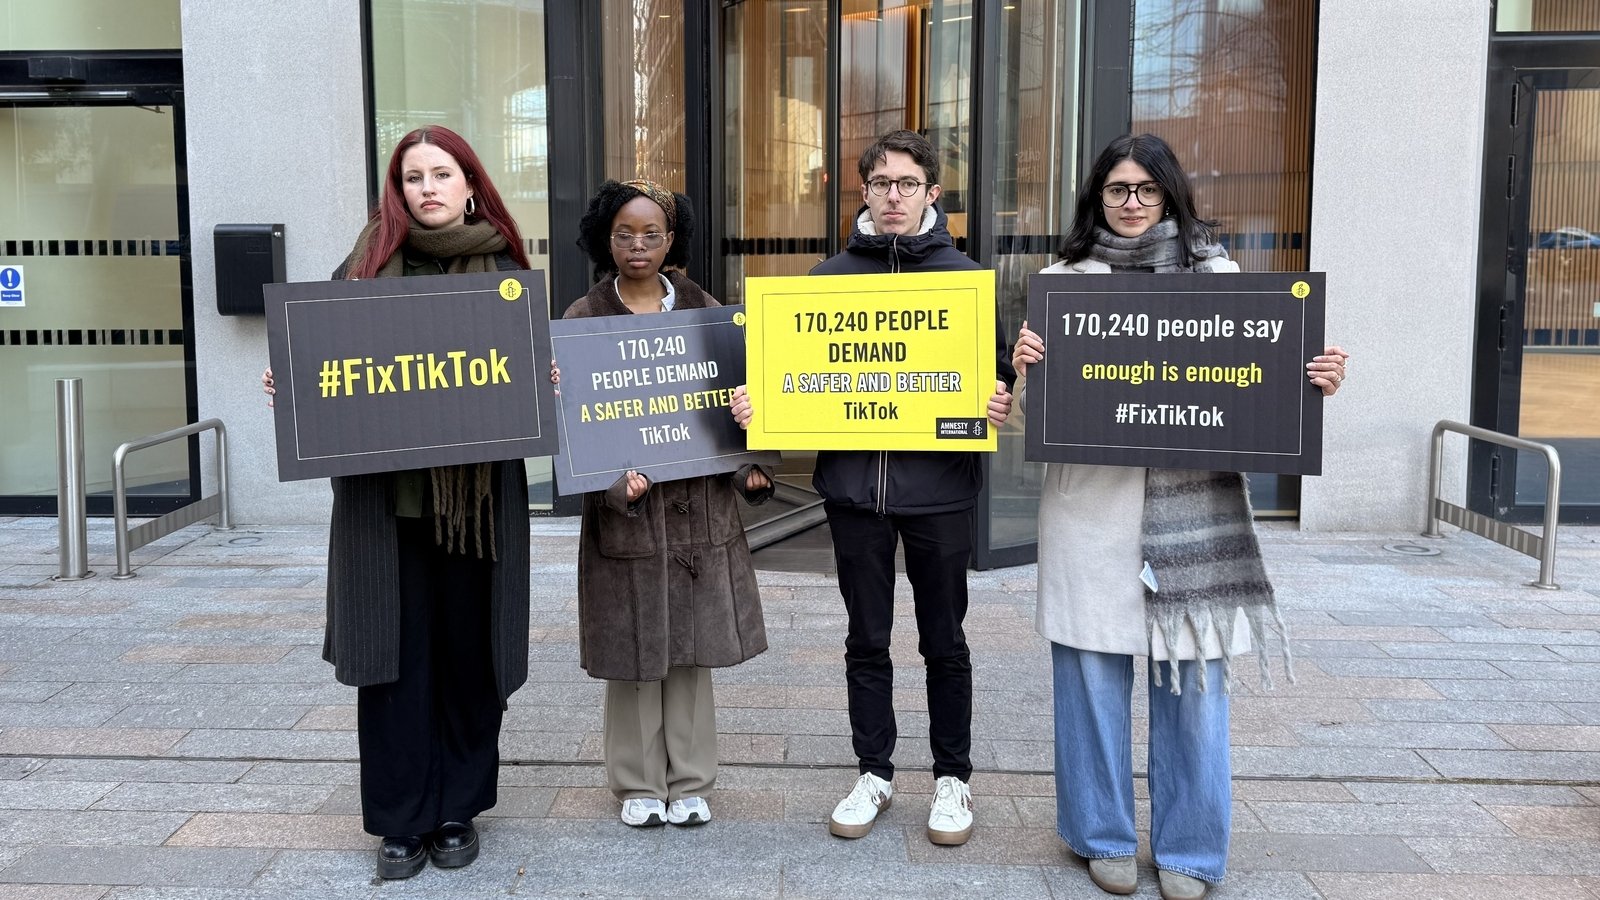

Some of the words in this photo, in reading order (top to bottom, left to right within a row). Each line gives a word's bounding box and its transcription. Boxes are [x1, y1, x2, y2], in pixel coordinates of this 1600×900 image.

[795, 312, 868, 335] 170,240
[875, 309, 949, 331] PEOPLE
[1062, 312, 1149, 339] 170,240
[1156, 314, 1235, 342] people
[1242, 319, 1284, 342] say
[617, 335, 686, 361] 170,240
[828, 341, 907, 363] DEMAND
[318, 348, 511, 398] #FixTikTok
[591, 367, 652, 391] PEOPLE
[656, 360, 719, 384] DEMAND
[782, 372, 795, 393] A
[798, 372, 852, 393] SAFER
[856, 372, 891, 393] AND
[896, 371, 962, 393] BETTER
[1081, 360, 1155, 385] enough
[1162, 361, 1179, 381] is
[1185, 363, 1263, 388] enough
[581, 404, 592, 423] A
[594, 399, 645, 421] SAFER
[649, 395, 679, 415] AND
[844, 401, 898, 420] TikTok
[1115, 403, 1225, 427] #FixTikTok
[639, 422, 692, 446] TikTok
[940, 422, 968, 430] AMNESTY
